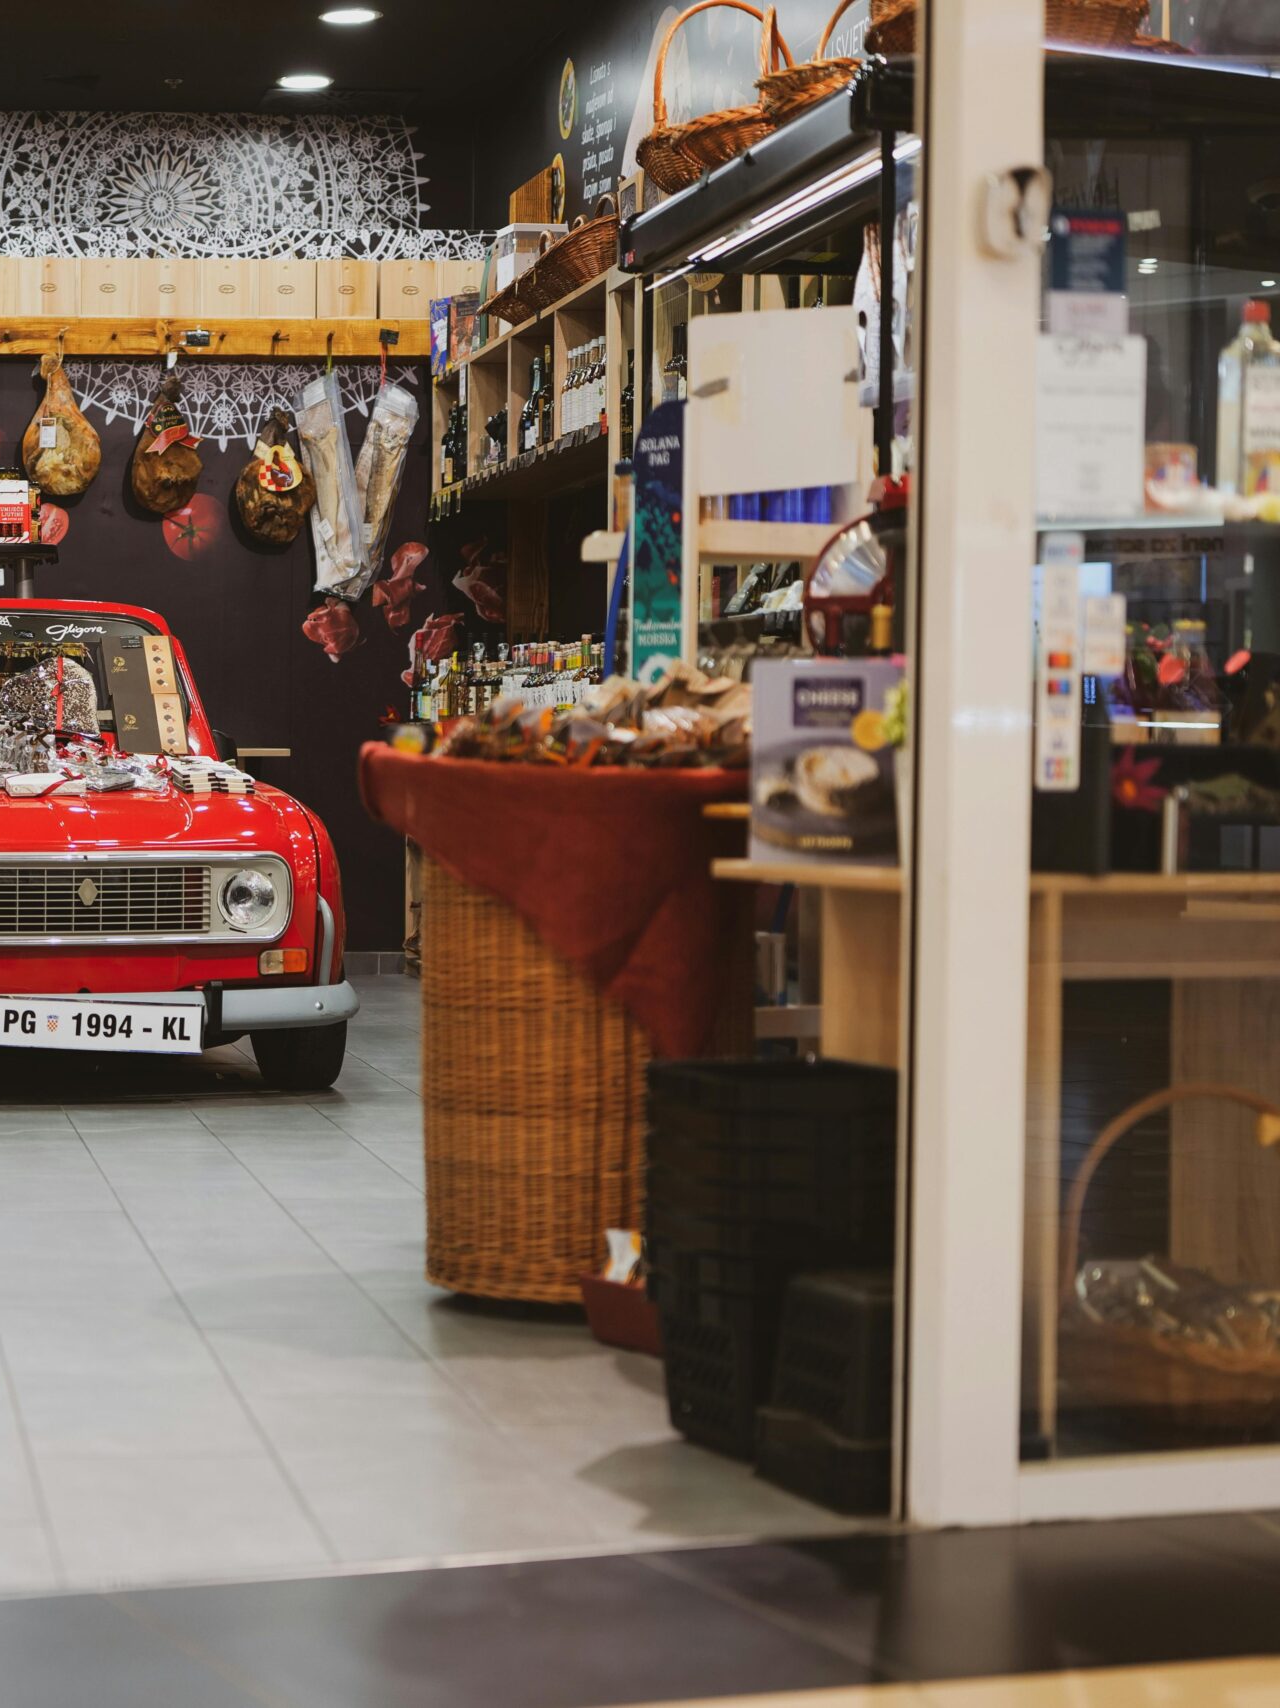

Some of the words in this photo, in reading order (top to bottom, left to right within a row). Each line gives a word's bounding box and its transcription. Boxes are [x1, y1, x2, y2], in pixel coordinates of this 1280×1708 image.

[640, 434, 681, 453] SOLANA
[648, 450, 671, 467] PAG
[45, 623, 107, 641] Gligora
[3, 1009, 36, 1034] PG
[72, 1012, 133, 1038] 1994
[162, 1016, 191, 1041] KL
